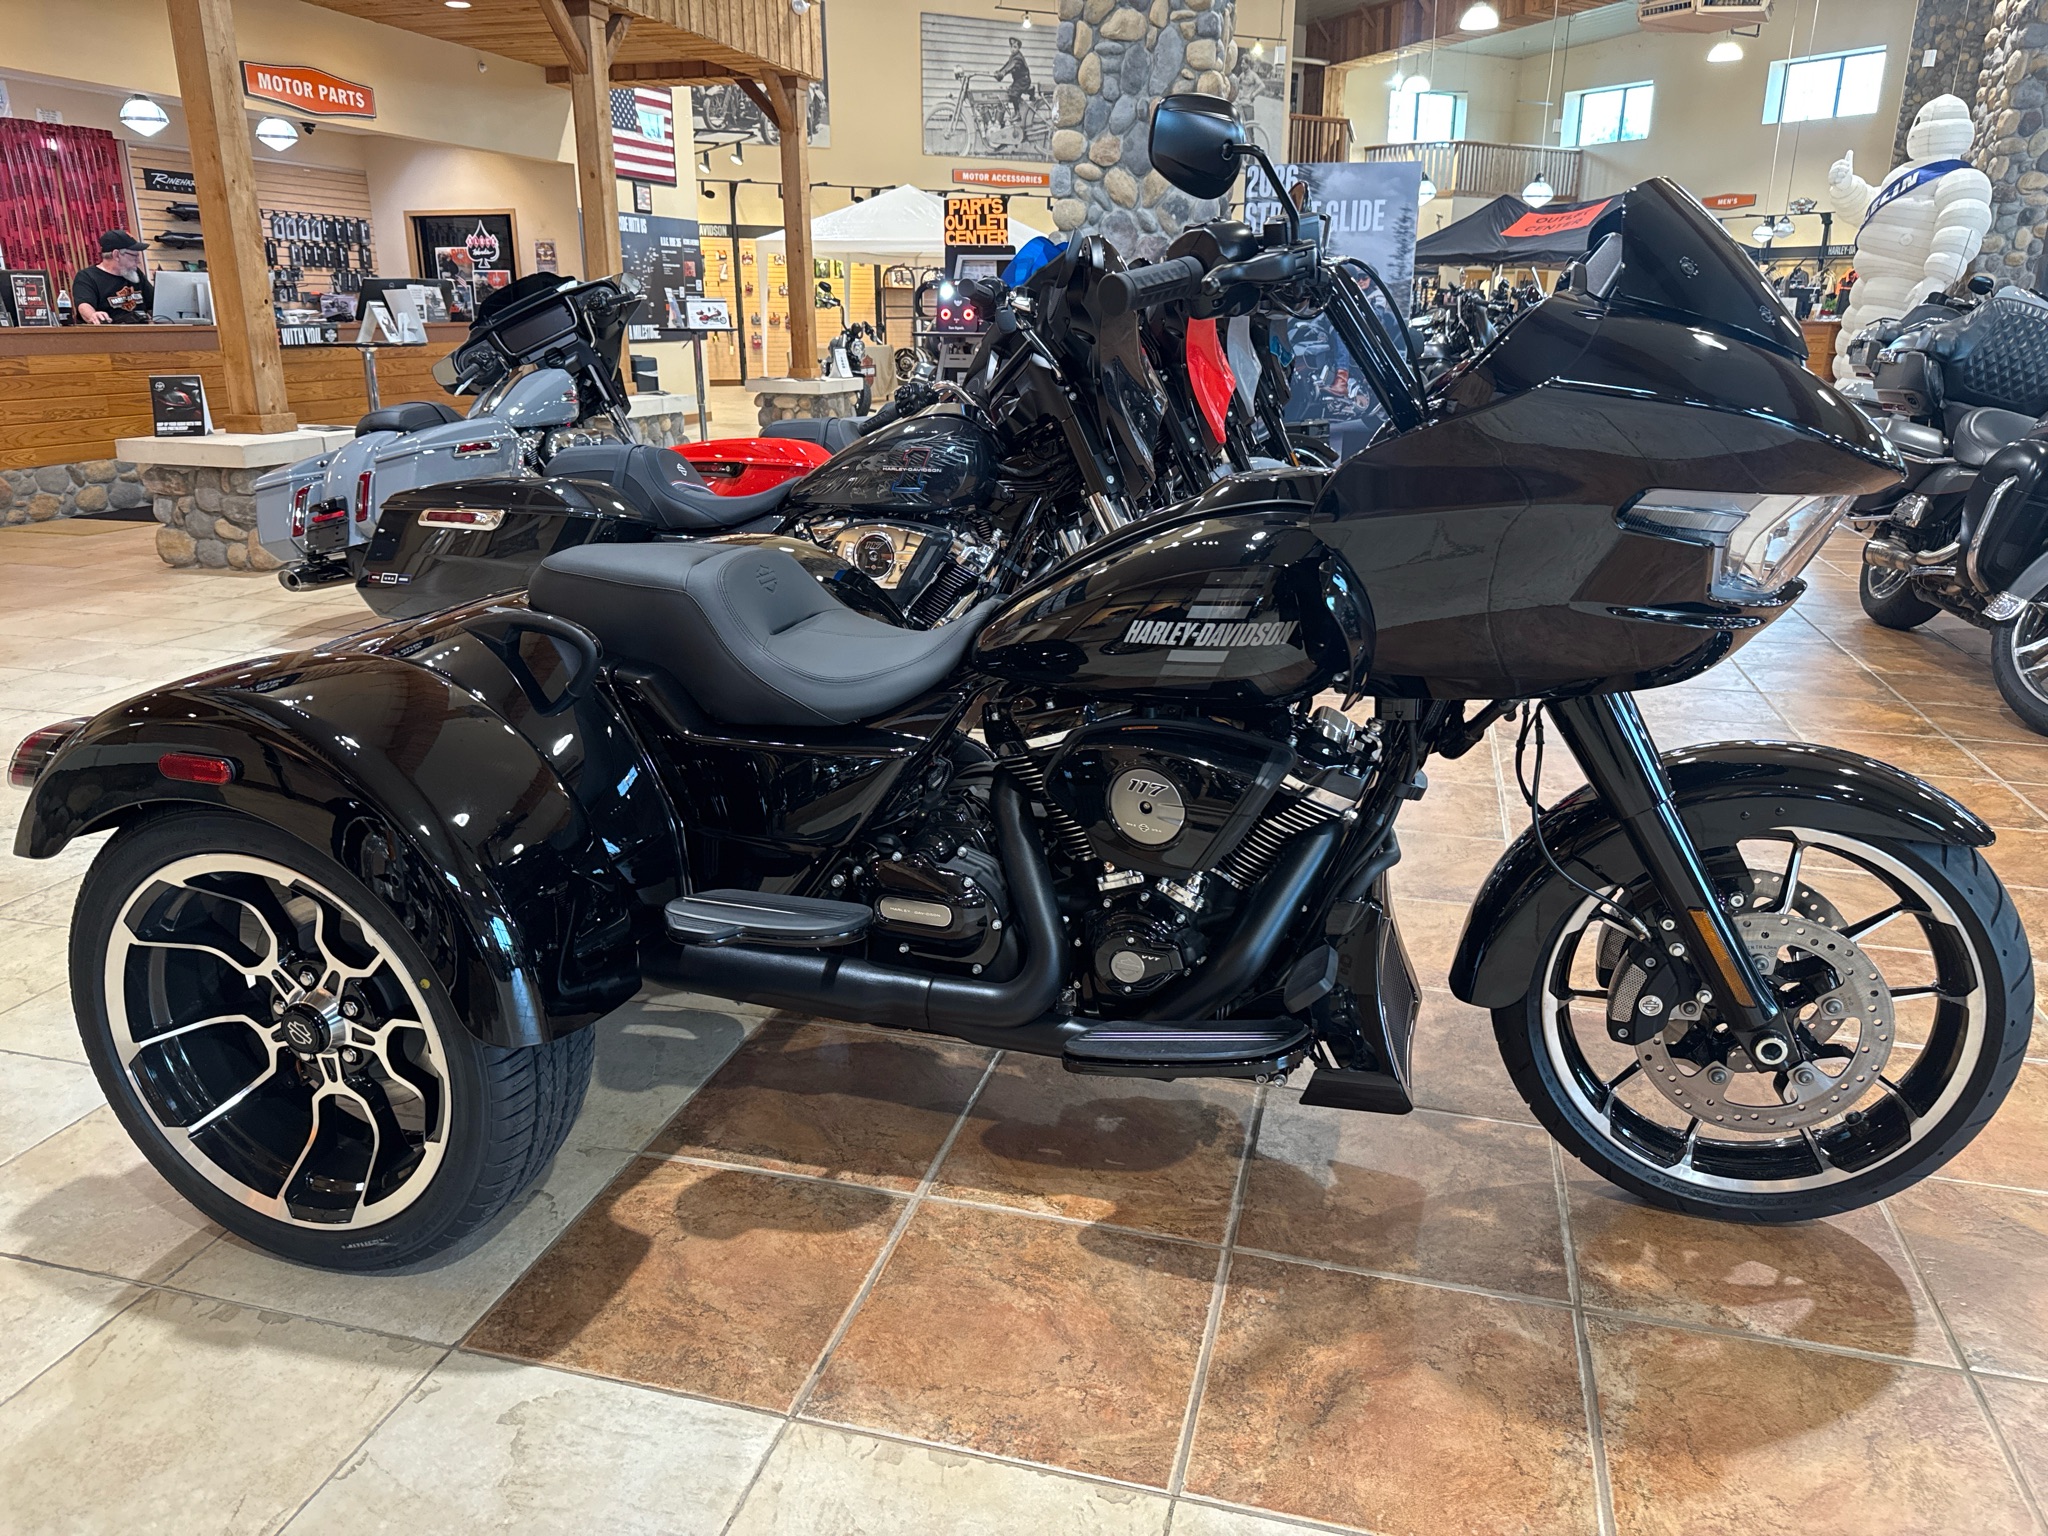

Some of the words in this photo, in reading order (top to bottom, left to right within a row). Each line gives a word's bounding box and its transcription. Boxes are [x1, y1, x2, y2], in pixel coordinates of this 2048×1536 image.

[257, 72, 314, 98] MOTOR
[318, 84, 365, 108] PARTS
[962, 172, 990, 181] MOTOR
[991, 173, 1043, 184] ACCESSORIES
[157, 184, 192, 192] RACIN
[948, 198, 1004, 215] PARTS
[1717, 197, 1738, 206] MEN'S
[945, 213, 1008, 231] OUTLET
[1325, 199, 1388, 233] GLIDE
[699, 224, 728, 237] AVIDSON
[1524, 218, 1584, 233] CENTER
[945, 229, 1008, 246] CENTER
[1828, 245, 1856, 255] HARLEY-DA
[36, 308, 47, 316] OFF
[280, 327, 305, 346] WITH
[304, 327, 324, 344] YOU.
[1123, 619, 1300, 647] HARLEY-DAVIDSON
[1127, 778, 1169, 797] 117
